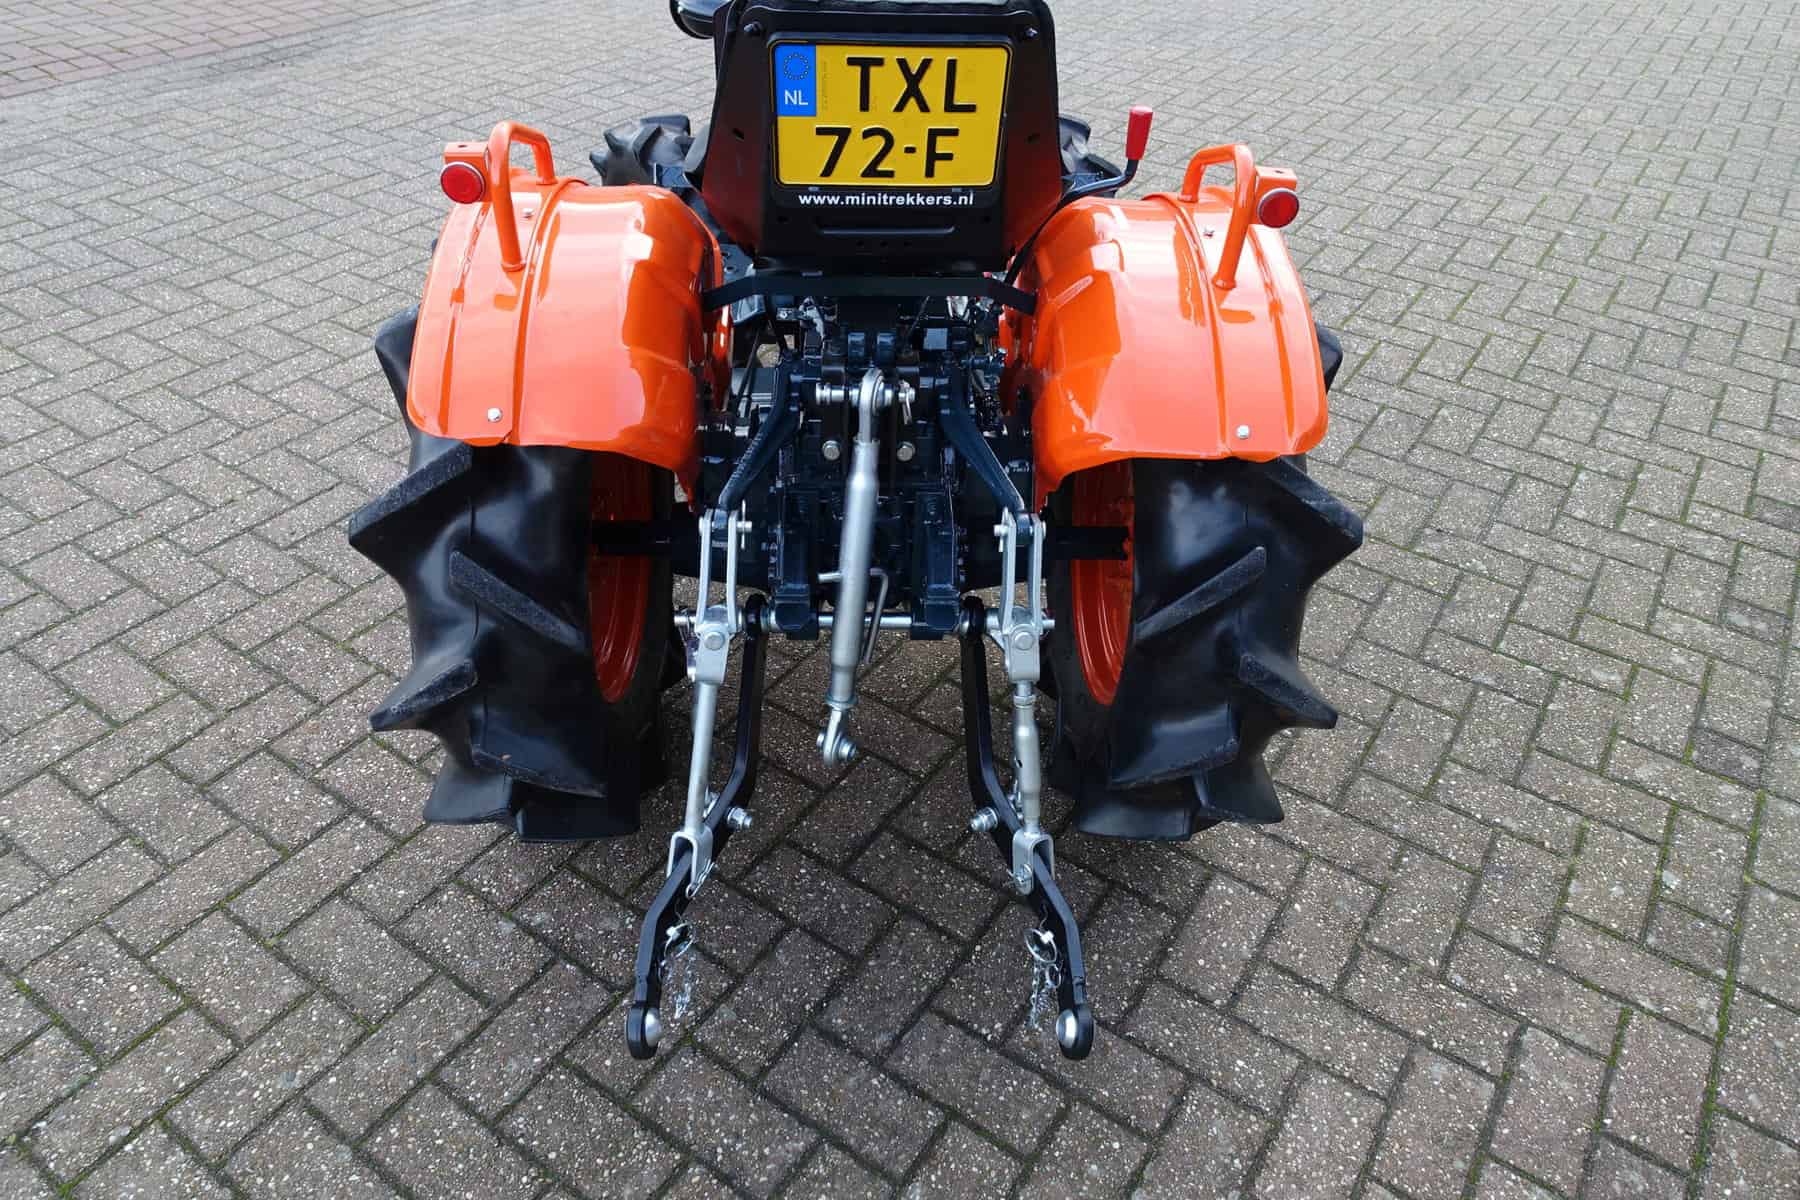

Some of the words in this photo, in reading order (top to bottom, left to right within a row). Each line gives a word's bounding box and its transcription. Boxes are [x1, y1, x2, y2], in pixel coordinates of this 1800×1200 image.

[784, 90, 808, 105] NL
[846, 57, 976, 113] TXL
[815, 127, 959, 178] 72-F
[799, 192, 973, 206] www.minitrekkers.nl
